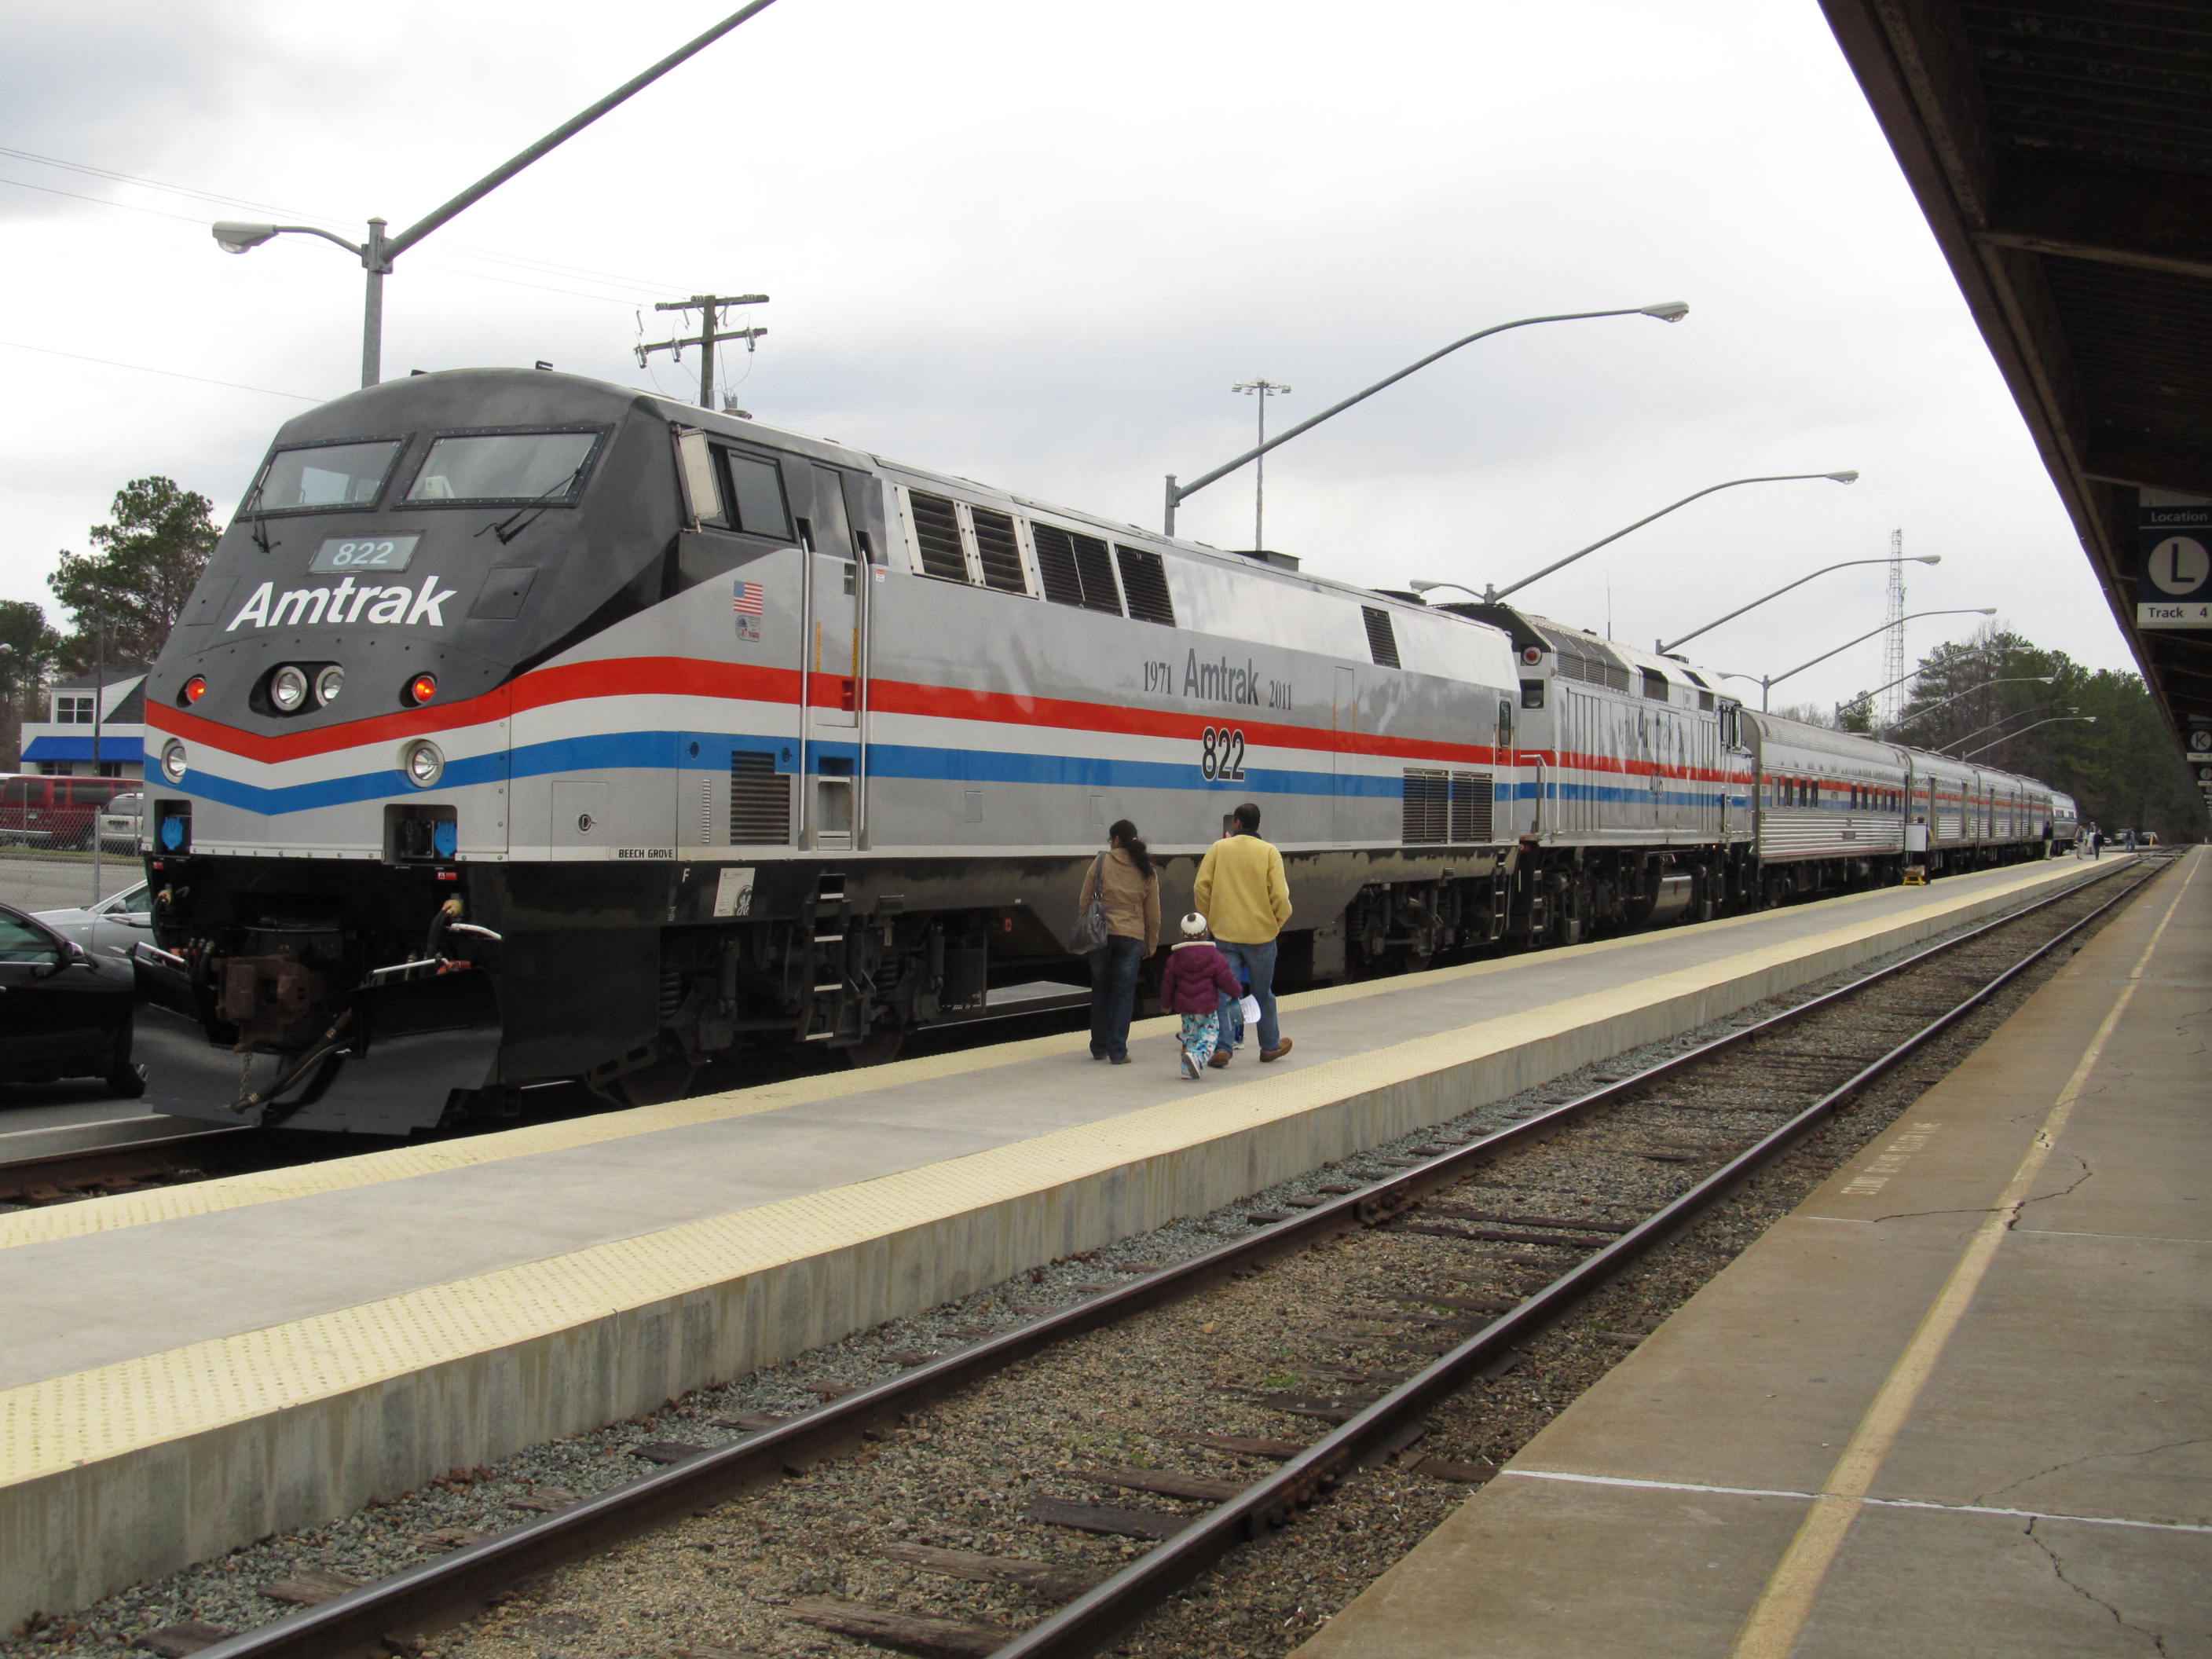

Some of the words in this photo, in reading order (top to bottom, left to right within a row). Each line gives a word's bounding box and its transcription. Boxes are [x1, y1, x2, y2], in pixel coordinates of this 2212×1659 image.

[2151, 511, 2208, 522] Location
[332, 541, 394, 566] 822
[2171, 543, 2196, 582] L
[226, 575, 457, 631] Amtrak
[2148, 606, 2184, 618] Track
[2199, 606, 2208, 618] 4
[1144, 660, 1171, 694] 1971
[1183, 648, 1258, 705] Amtrak
[1269, 680, 1291, 710] 2011
[2196, 733, 2207, 748] K
[1202, 726, 1245, 781] 822
[619, 849, 645, 859] BEECH
[648, 849, 673, 859] GROVE
[682, 868, 690, 883] F
